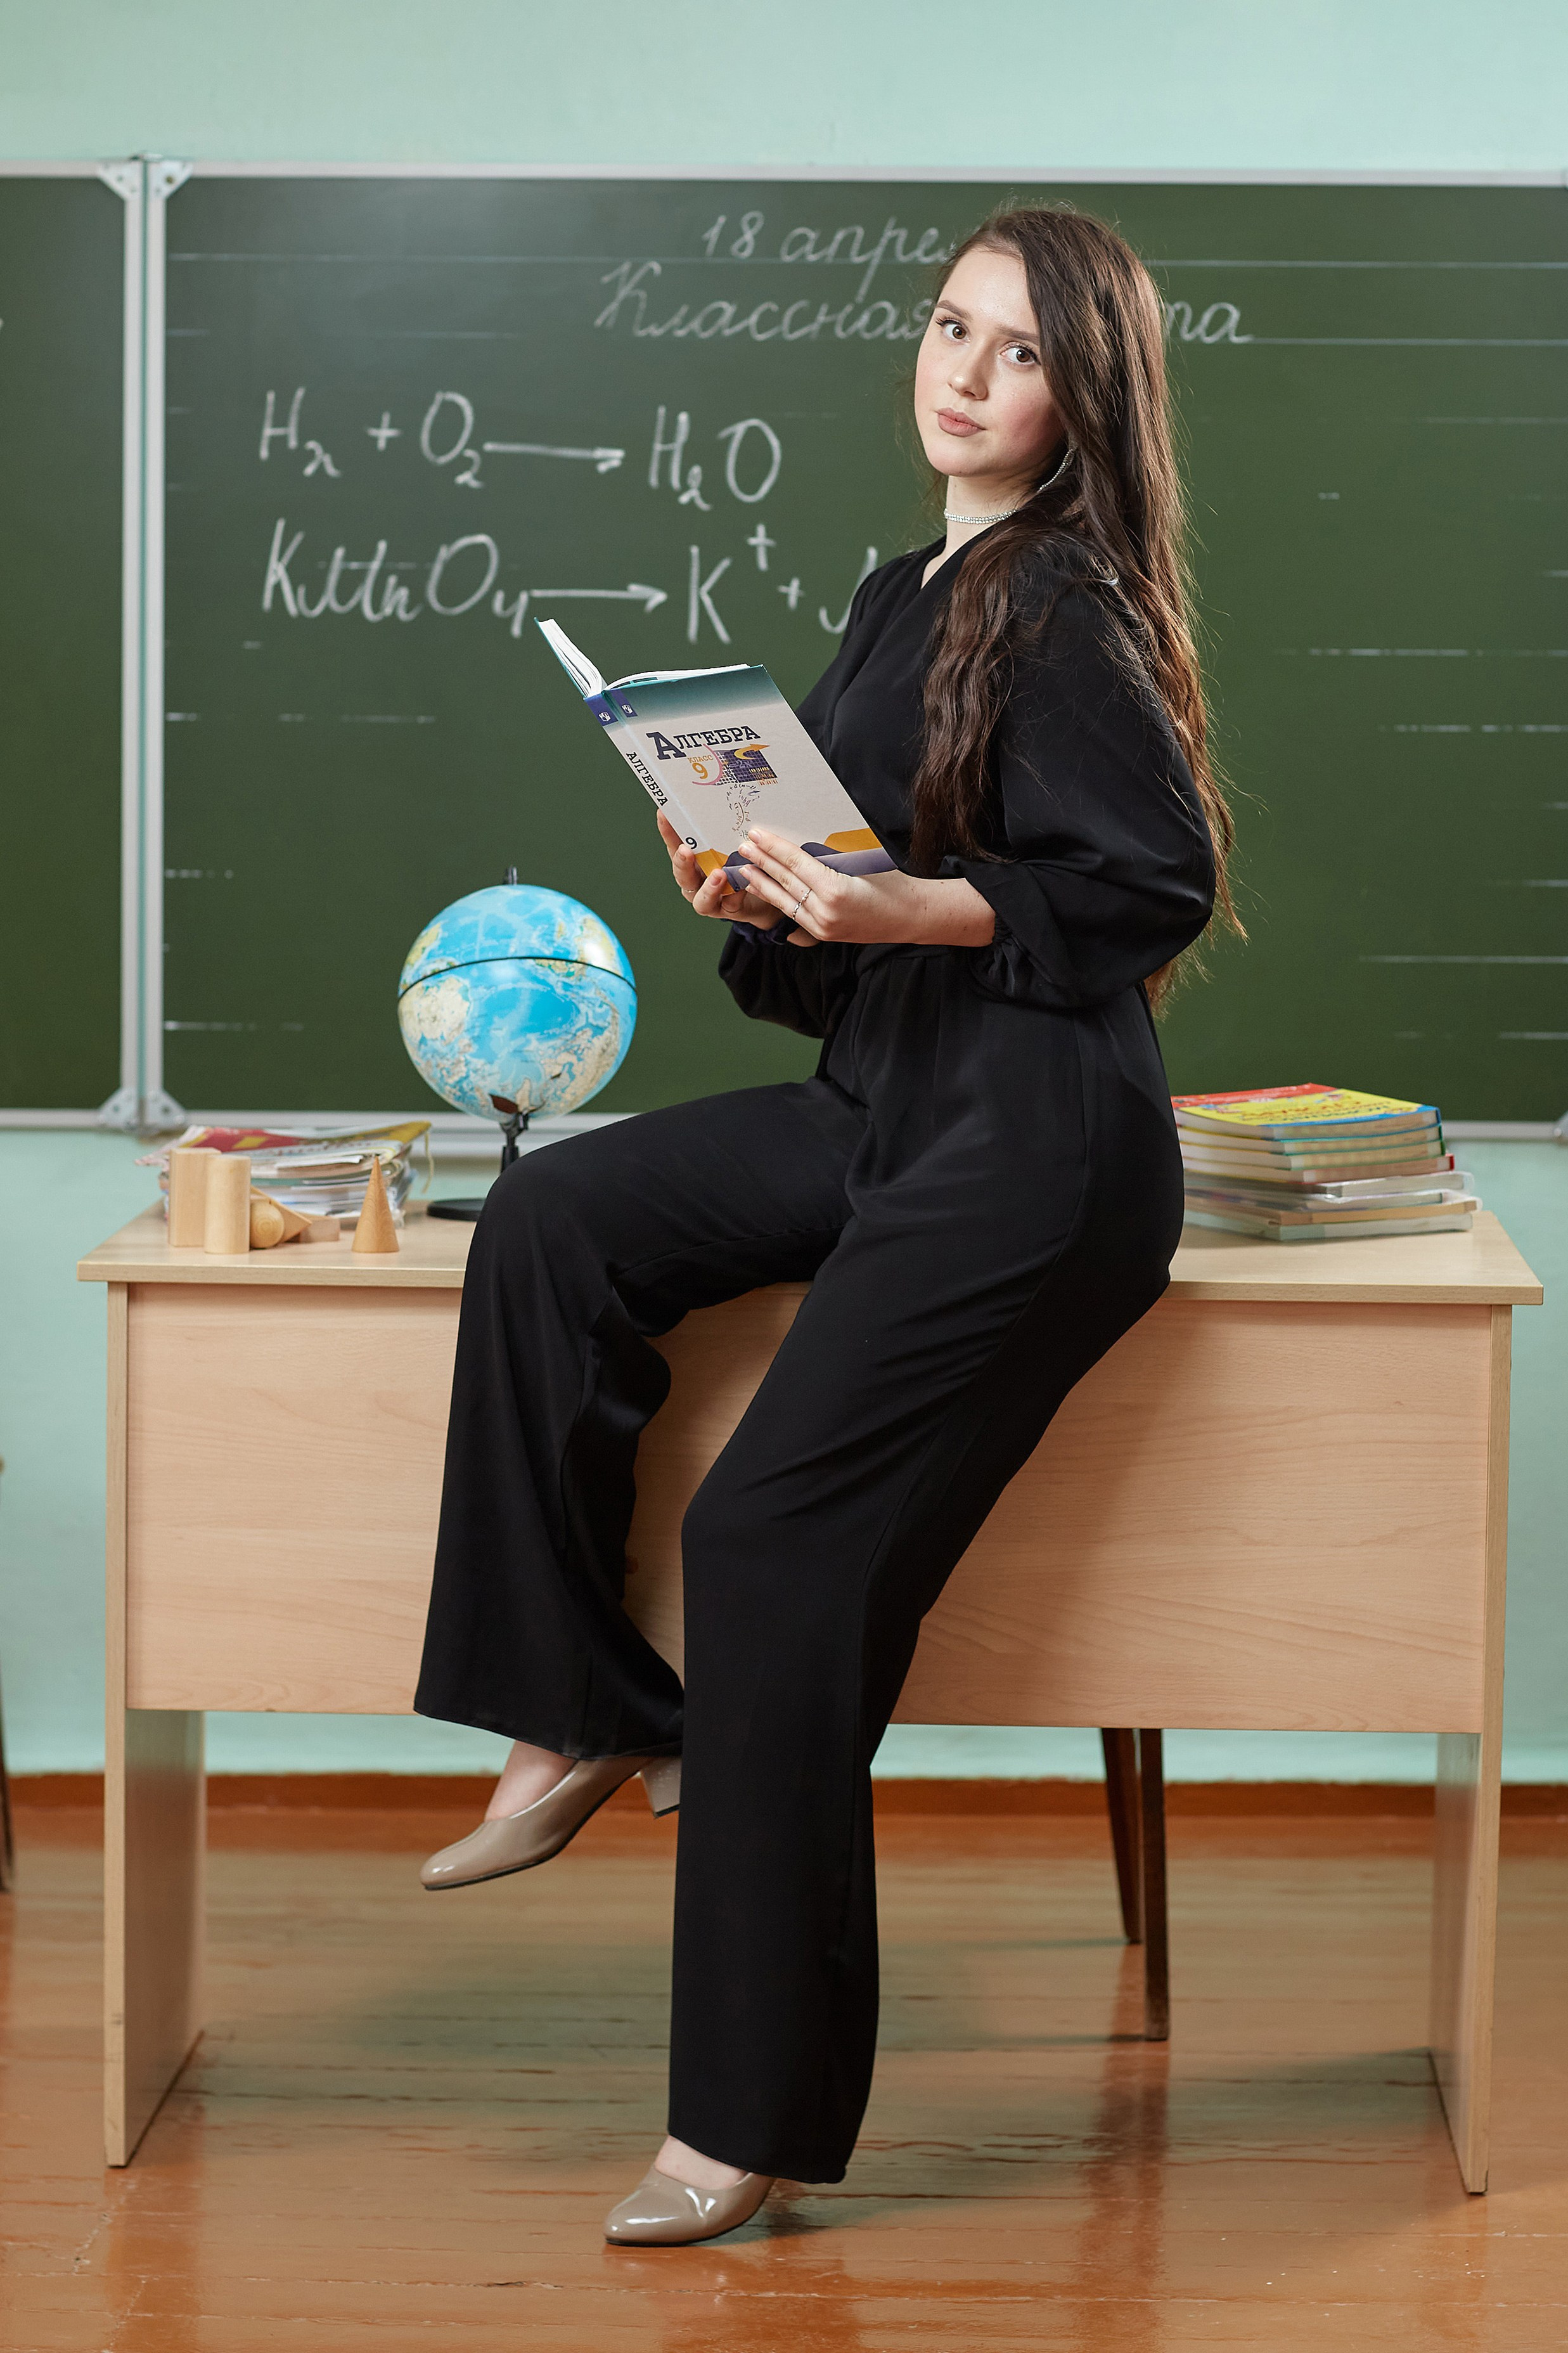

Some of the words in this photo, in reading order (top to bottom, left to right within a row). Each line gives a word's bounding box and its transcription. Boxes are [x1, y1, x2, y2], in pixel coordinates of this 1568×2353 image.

[702, 210, 764, 257] 18
[780, 216, 947, 303] апре
[646, 725, 761, 760] АЛГЕБРА
[626, 752, 669, 806] АЛГЕБРА
[691, 763, 709, 780] 9
[685, 837, 698, 849] 9
